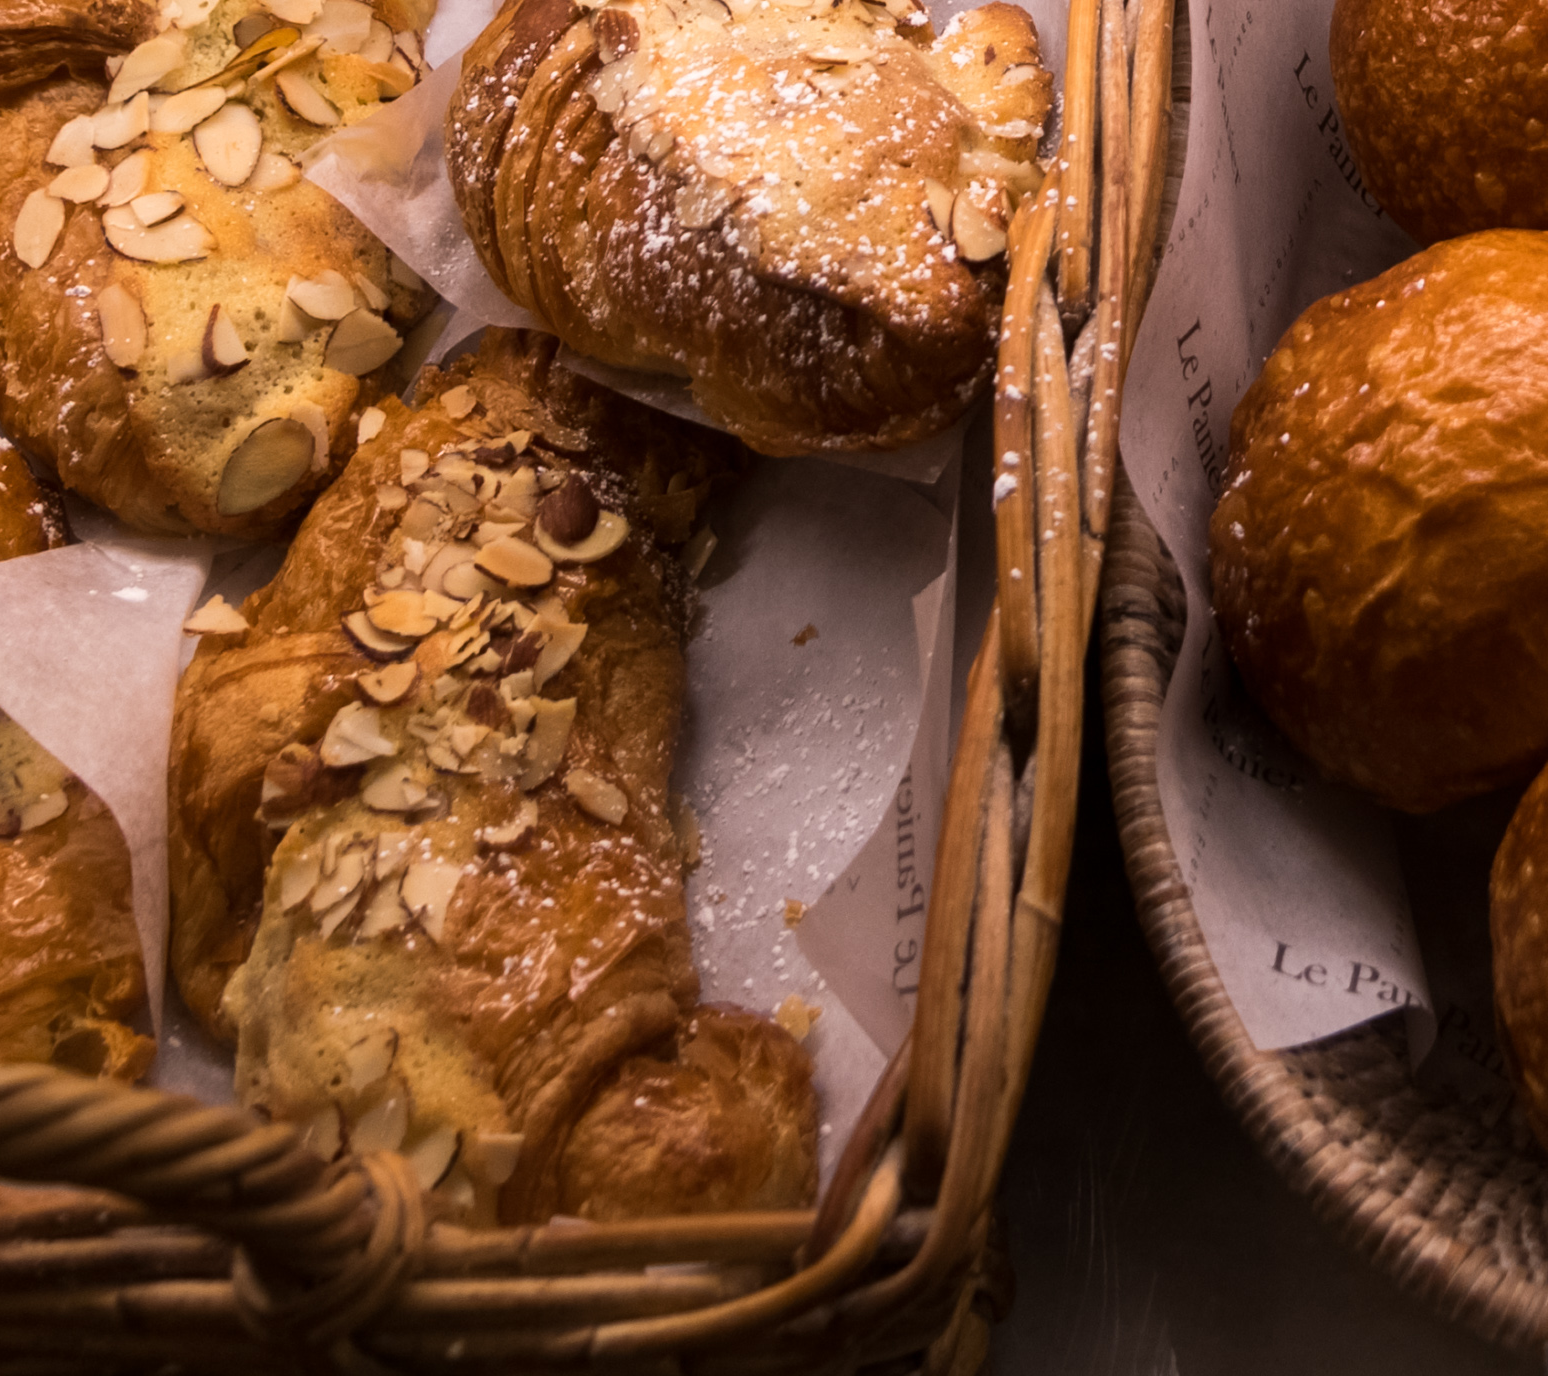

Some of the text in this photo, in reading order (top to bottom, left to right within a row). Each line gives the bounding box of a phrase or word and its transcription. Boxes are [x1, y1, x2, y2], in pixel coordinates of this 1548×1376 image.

[1292, 51, 1390, 220] Le Panier
[1297, 177, 1323, 226] Very
[1175, 317, 1225, 500] Le Panie
[1271, 939, 1328, 988] Le
